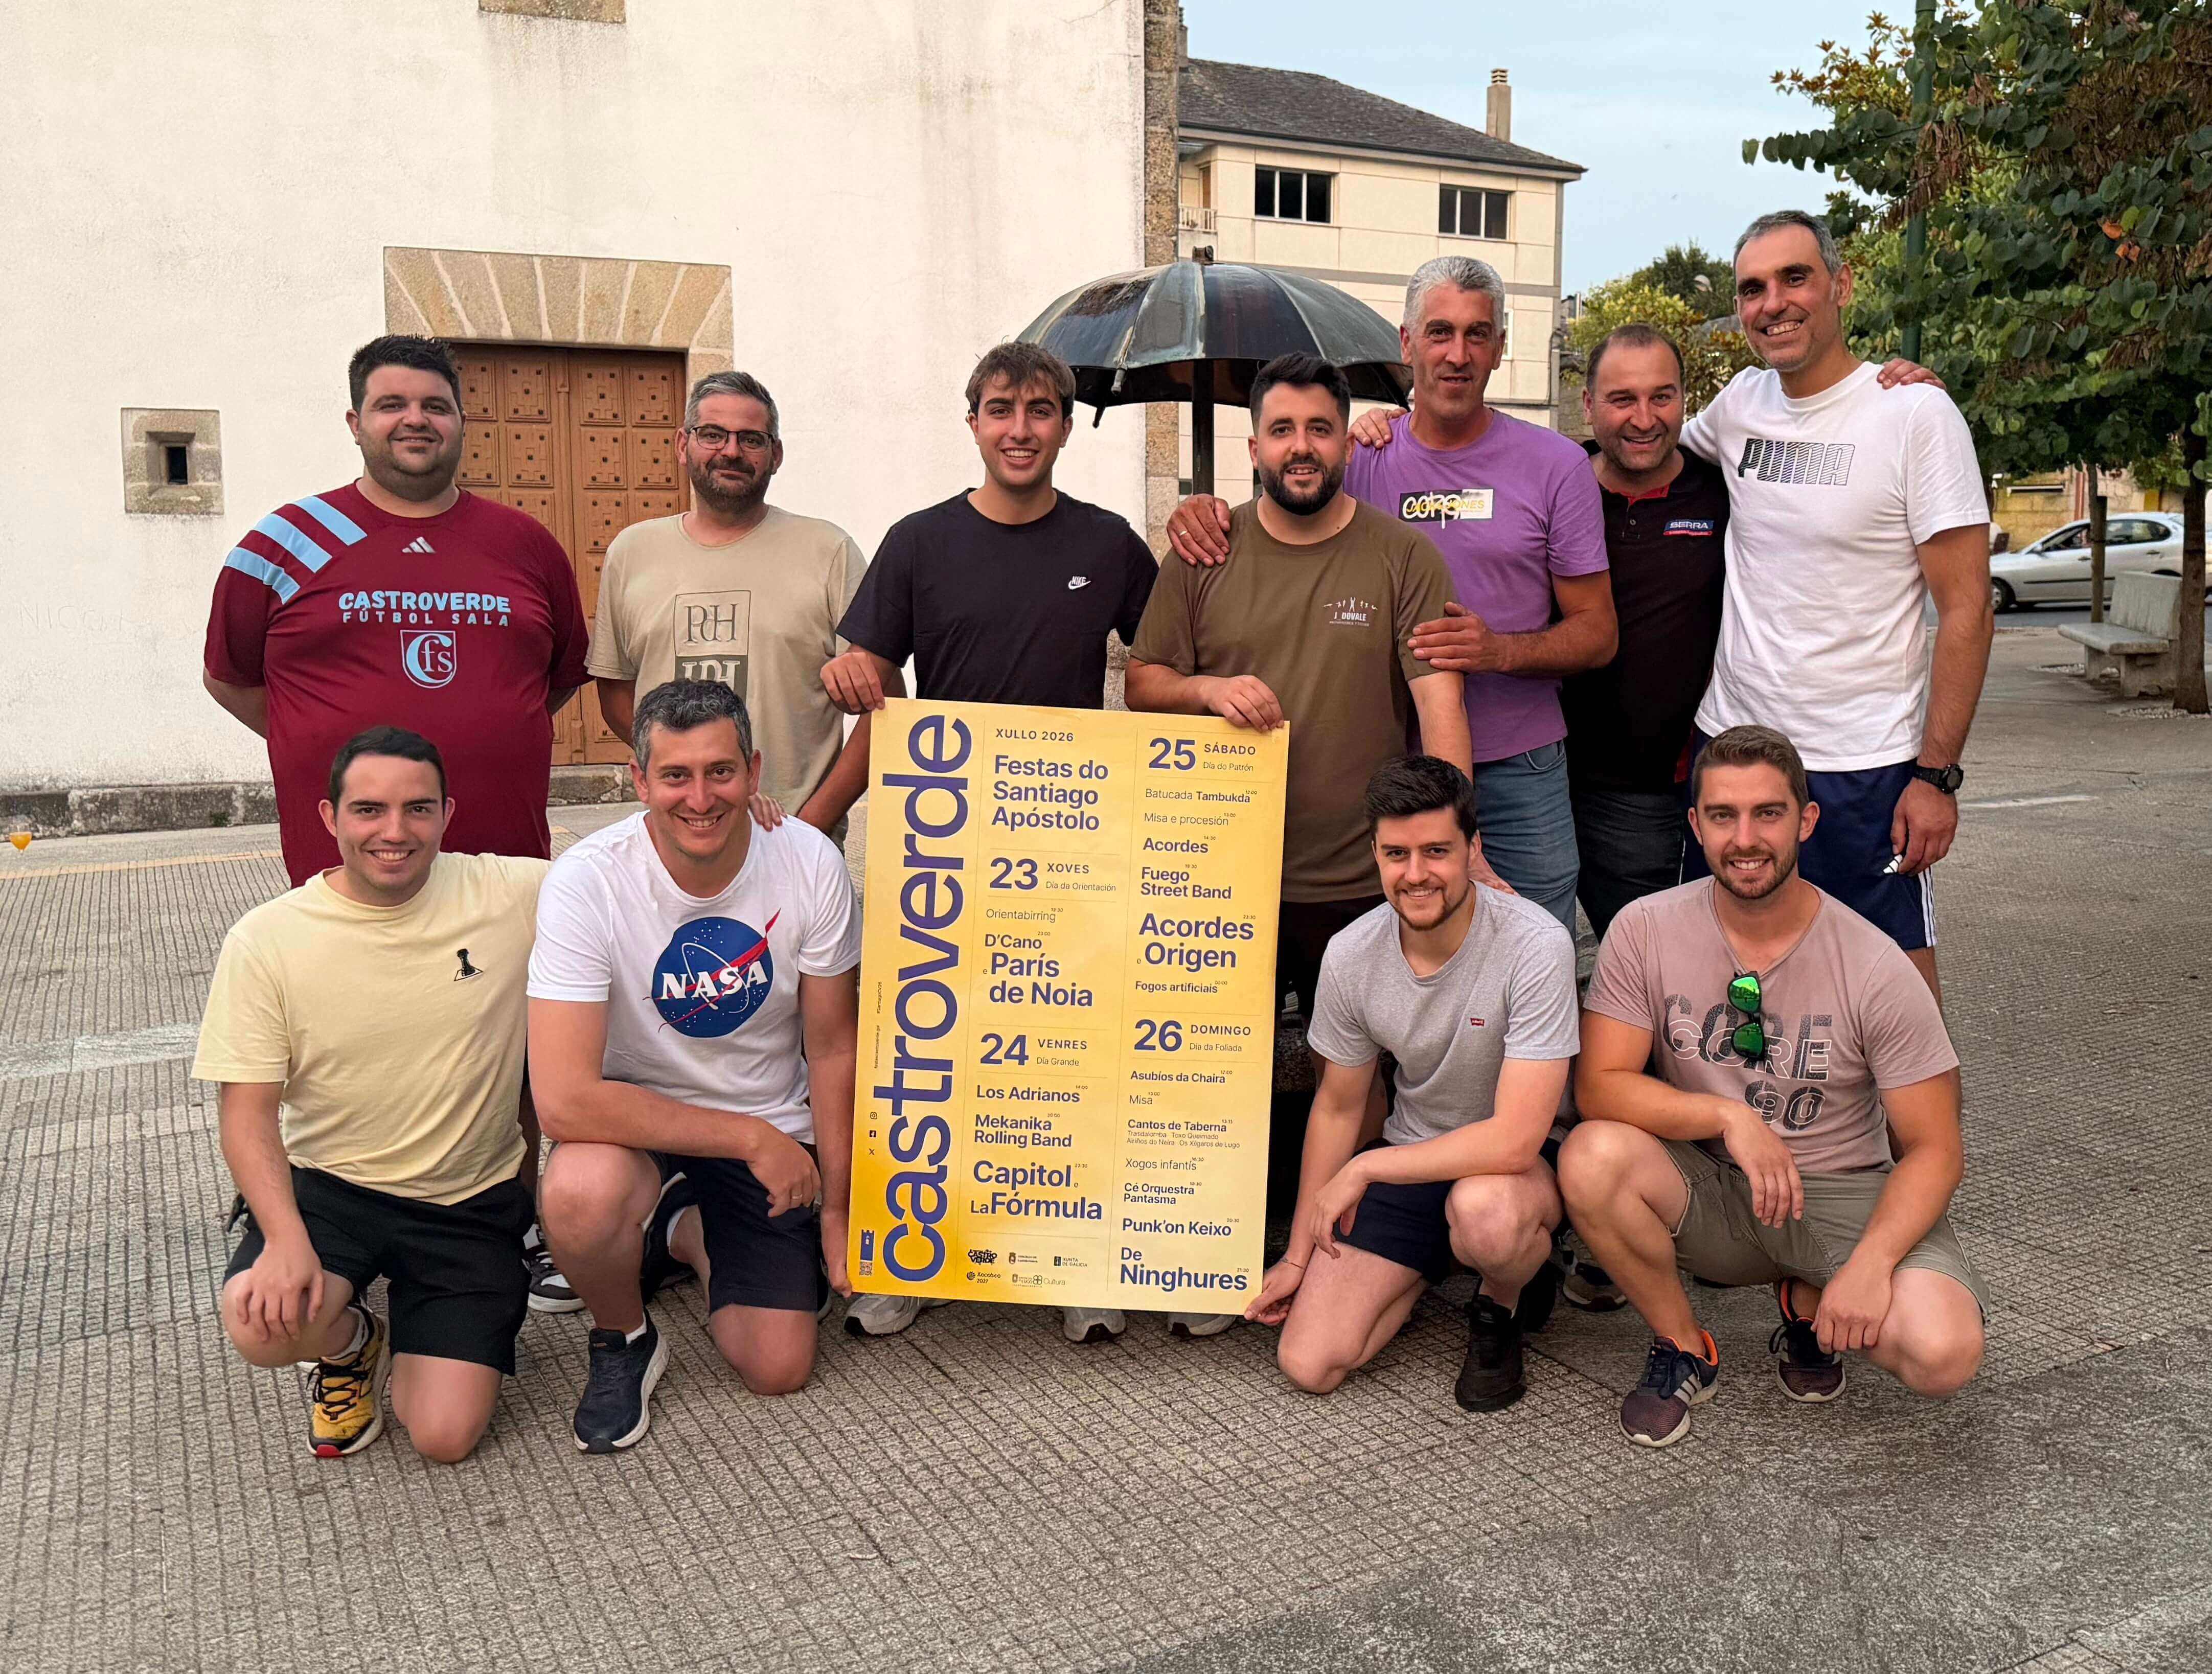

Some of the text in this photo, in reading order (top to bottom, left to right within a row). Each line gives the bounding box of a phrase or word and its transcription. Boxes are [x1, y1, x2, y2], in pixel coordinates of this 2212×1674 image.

[1738, 438, 1855, 486] PUMA
[1072, 576, 1086, 585] NIKE
[338, 591, 511, 612] CASTROVERDE
[343, 608, 508, 627] FÚTBOL SALA
[996, 729, 1074, 741] XULLO 2026
[1149, 738, 1256, 770] 25 SÁBADO
[995, 754, 1108, 779] Festas do
[993, 781, 1098, 809] Santiago
[1146, 789, 1192, 799] Batucada
[1196, 791, 1250, 802] Tambukda
[992, 807, 1099, 831] Apóstolo
[1145, 813, 1168, 822] Misa
[1180, 817, 1228, 825] procesión
[1143, 837, 1208, 853] Acordes
[990, 857, 1089, 890] 23 XOVES
[1142, 867, 1190, 884] Fuego
[1073, 883, 1116, 891] Orientación
[1141, 882, 1232, 899] Street Band
[986, 909, 1056, 923] Orientabirring
[1139, 913, 1253, 939] Acordes
[991, 952, 1059, 977] París
[1145, 942, 1236, 973] Origen
[661, 961, 768, 1000] NASA
[1135, 981, 1167, 993] Fogos
[1170, 983, 1218, 993] artificiais
[989, 980, 1092, 1006] de Noia
[1134, 1019, 1251, 1051] 26 DOMINGO
[980, 1033, 1087, 1066] 24 VENRES
[1130, 1071, 1173, 1081] Asubíos
[1176, 1073, 1189, 1082] da
[1192, 1073, 1225, 1083] Chaira
[977, 1085, 1004, 1098] Los
[1009, 1087, 1080, 1103] Adrianos
[1129, 1095, 1153, 1105] Misa
[975, 1114, 1052, 1131] Mekanika
[1128, 1119, 1165, 1130] Cantos
[1168, 1121, 1181, 1130] de
[1184, 1121, 1226, 1132] Taberna
[974, 1130, 1072, 1149] Rolling Band
[1126, 1158, 1157, 1170] Xogos
[1161, 1160, 1196, 1170] infantís
[973, 1160, 1071, 1190] Capitol
[1125, 1182, 1139, 1192] Cé
[1142, 1183, 1194, 1195] Orquestra
[971, 1191, 1102, 1220] La Fórmula
[1124, 1194, 1176, 1204] Pantasma
[1189, 1221, 1232, 1236] Keixo
[1121, 1247, 1142, 1260] De
[1120, 1264, 1247, 1292] Ninghures
